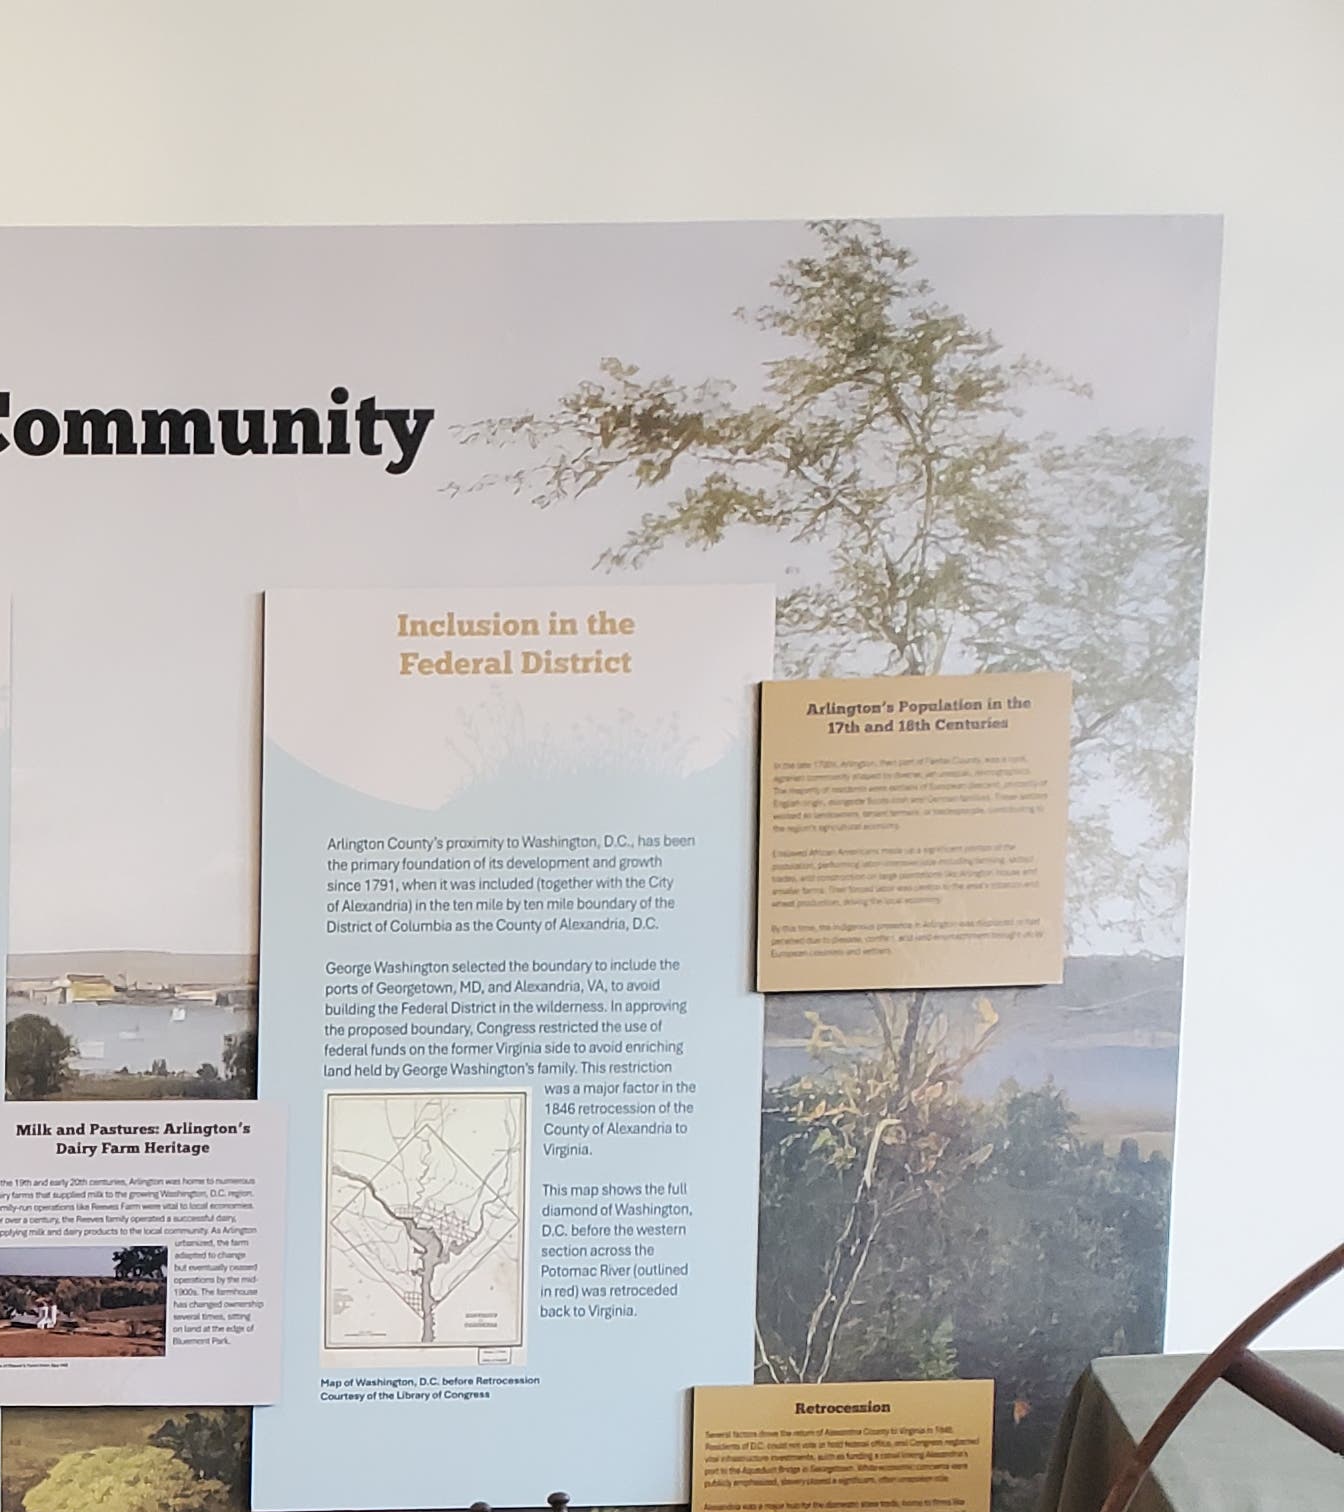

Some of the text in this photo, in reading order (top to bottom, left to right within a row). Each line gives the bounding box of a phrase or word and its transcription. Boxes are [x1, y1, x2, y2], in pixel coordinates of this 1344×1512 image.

[397, 611, 634, 636] Inclusion in the
[399, 650, 631, 675] Federal District
[326, 837, 384, 853] Arlington
[387, 836, 443, 851] County's
[445, 836, 504, 852] proximity
[506, 837, 519, 848] to
[521, 836, 600, 850] Washington,
[638, 835, 660, 847] has
[663, 834, 694, 846] been
[16, 1122, 250, 1137] Milk and Pastures: Arlington's
[56, 1141, 209, 1157] Dairy Farm Heritage
[320, 1379, 341, 1388] Map
[343, 1378, 353, 1387] of
[442, 1377, 473, 1385] before
[476, 1376, 539, 1384] Retrocession
[795, 1401, 890, 1414] Retrocession
